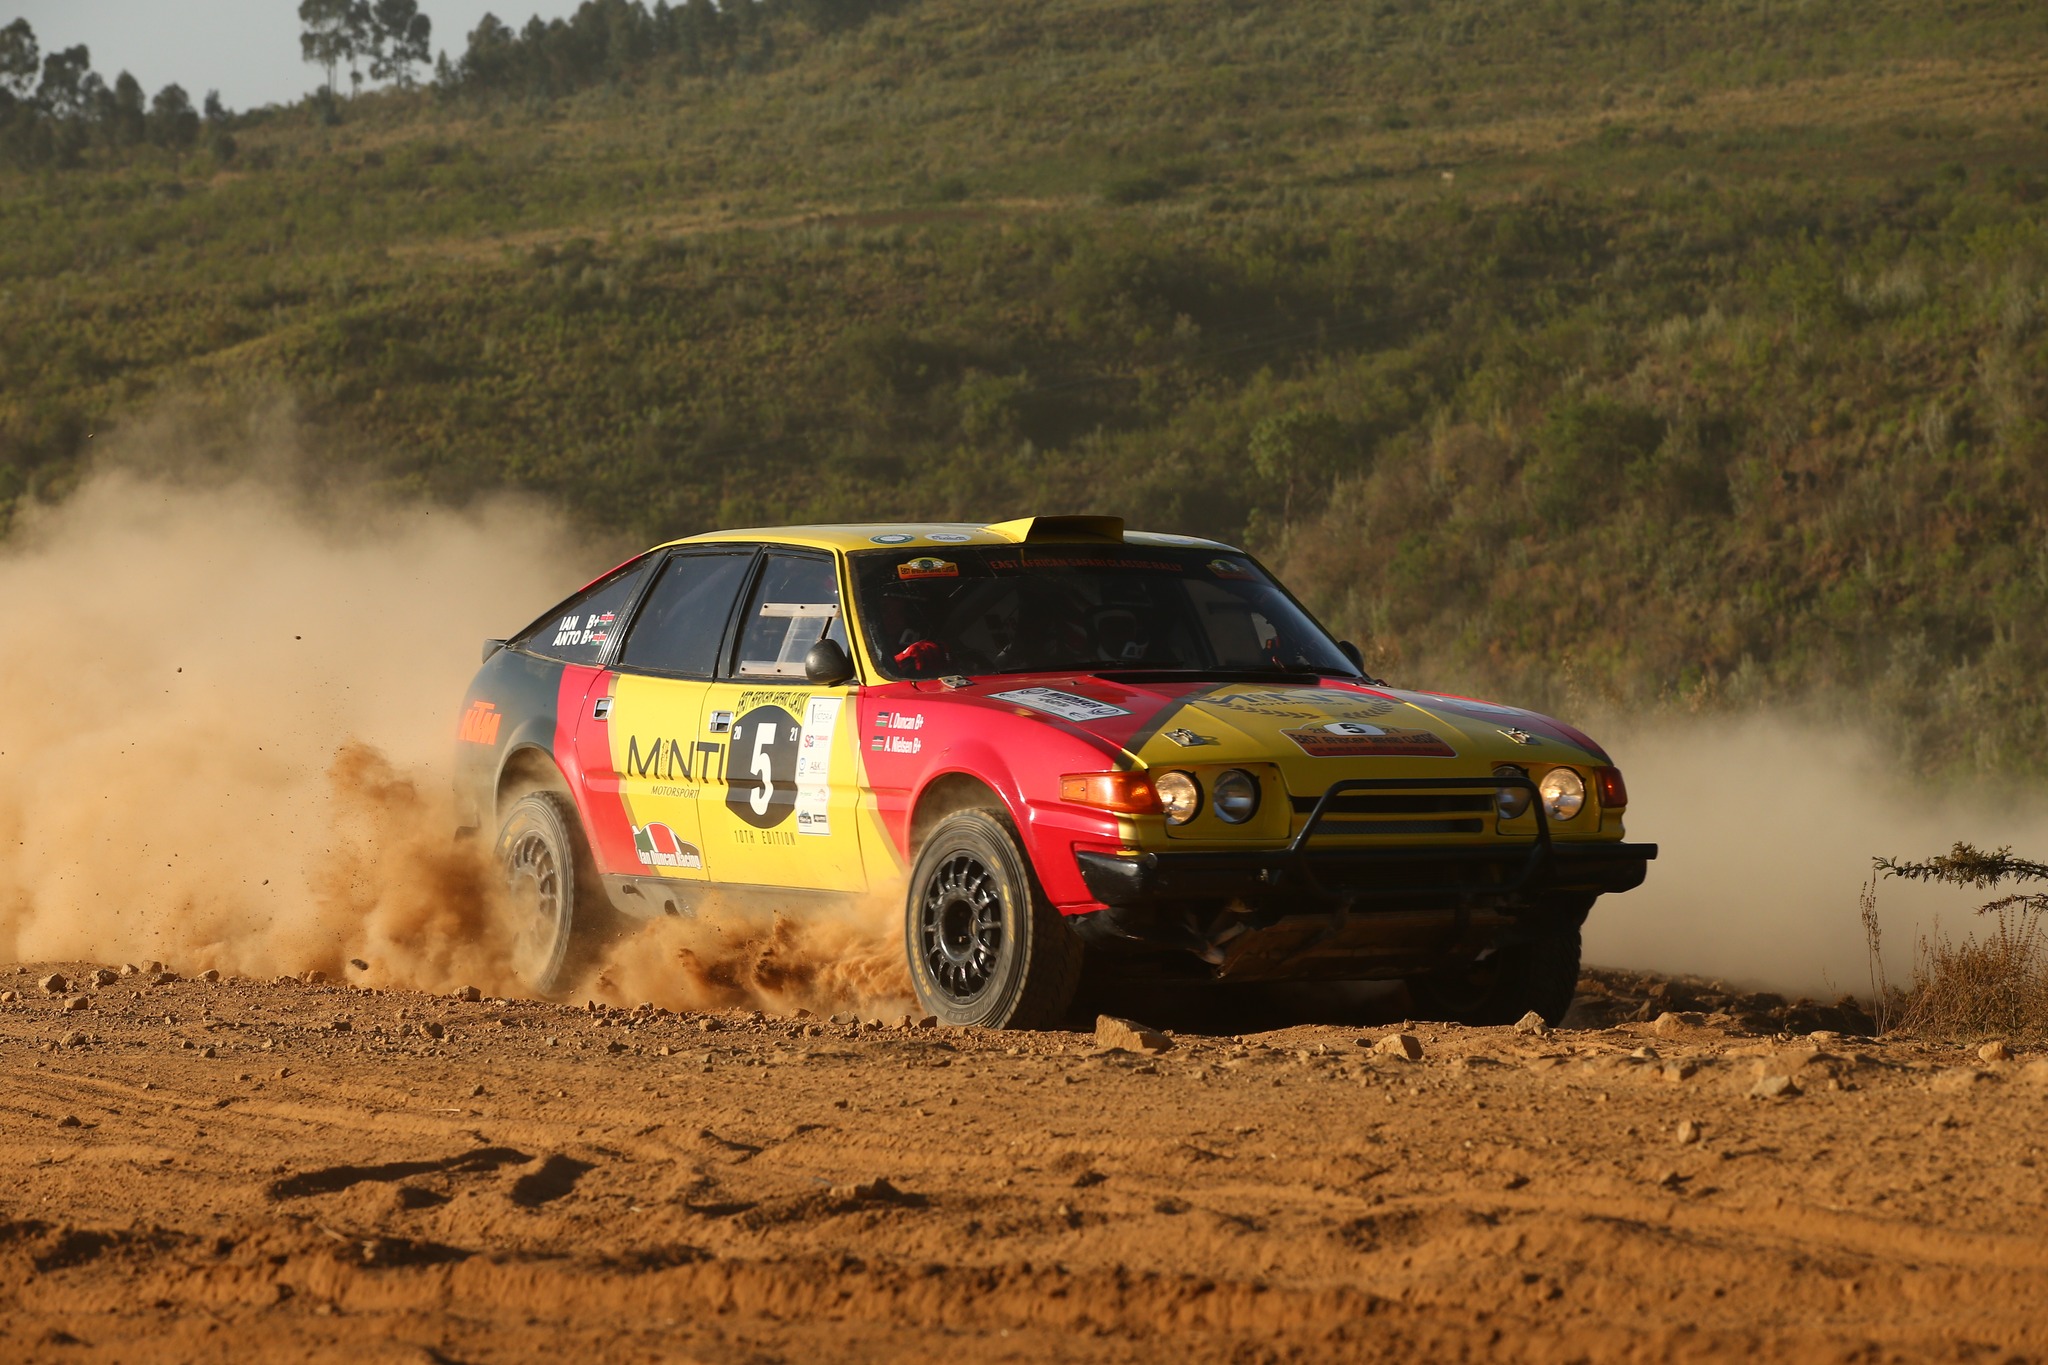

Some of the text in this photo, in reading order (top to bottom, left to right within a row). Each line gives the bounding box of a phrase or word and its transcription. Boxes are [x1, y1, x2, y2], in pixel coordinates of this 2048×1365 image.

[990, 560, 1018, 570] EAST
[1021, 559, 1068, 568] AFRICAN
[1068, 558, 1108, 568] SAFARI
[559, 614, 600, 631] IAN B+
[552, 630, 594, 646] ANTO B+
[459, 701, 501, 745] KTM
[893, 712, 915, 730] Duncan
[914, 713, 924, 730] B+
[1339, 723, 1366, 734] 5
[733, 726, 798, 741] 20 21
[891, 736, 913, 753] Nielsen
[912, 737, 921, 754] B+
[750, 723, 777, 815] 5
[651, 786, 699, 799] MOTORSPORT
[734, 830, 796, 846] 10TH EDITION
[638, 849, 702, 870] Ian Duncan Racing
